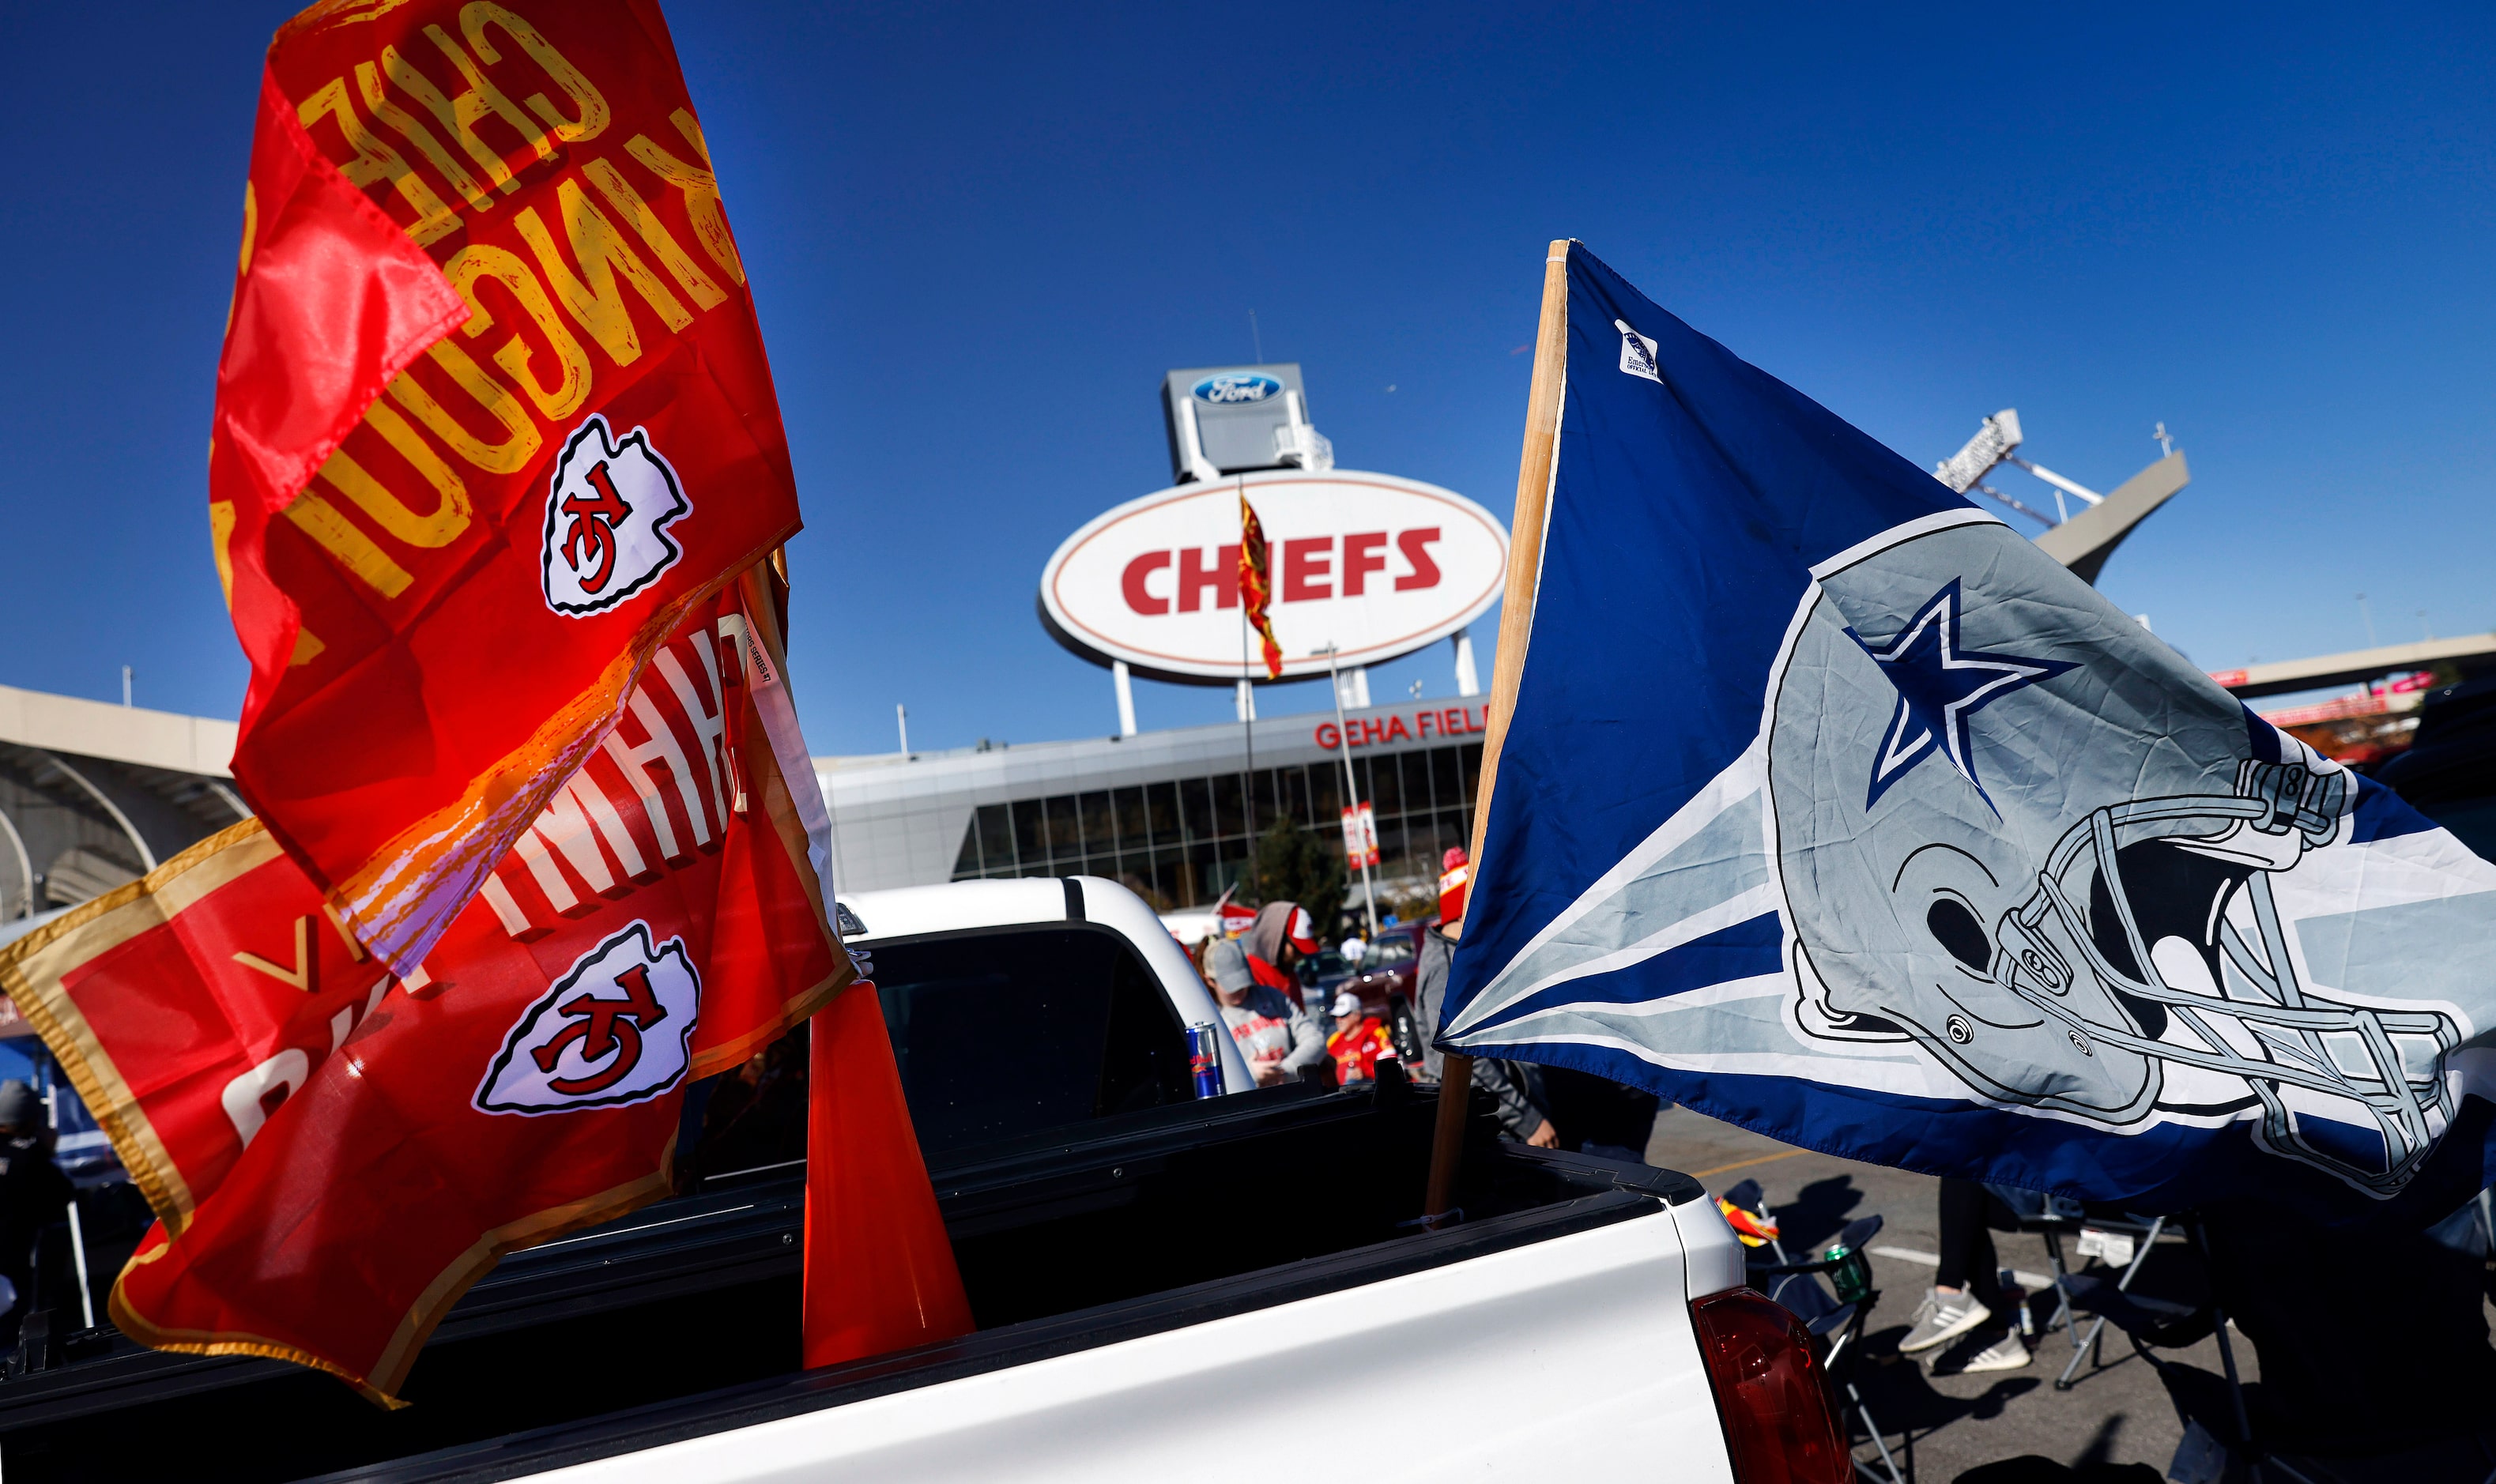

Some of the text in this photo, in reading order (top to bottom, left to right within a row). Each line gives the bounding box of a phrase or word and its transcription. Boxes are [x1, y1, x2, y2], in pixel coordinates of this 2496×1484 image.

[1208, 375, 1266, 403] Ford
[750, 646, 768, 674] SERIES
[1314, 714, 1412, 749] GEHA
